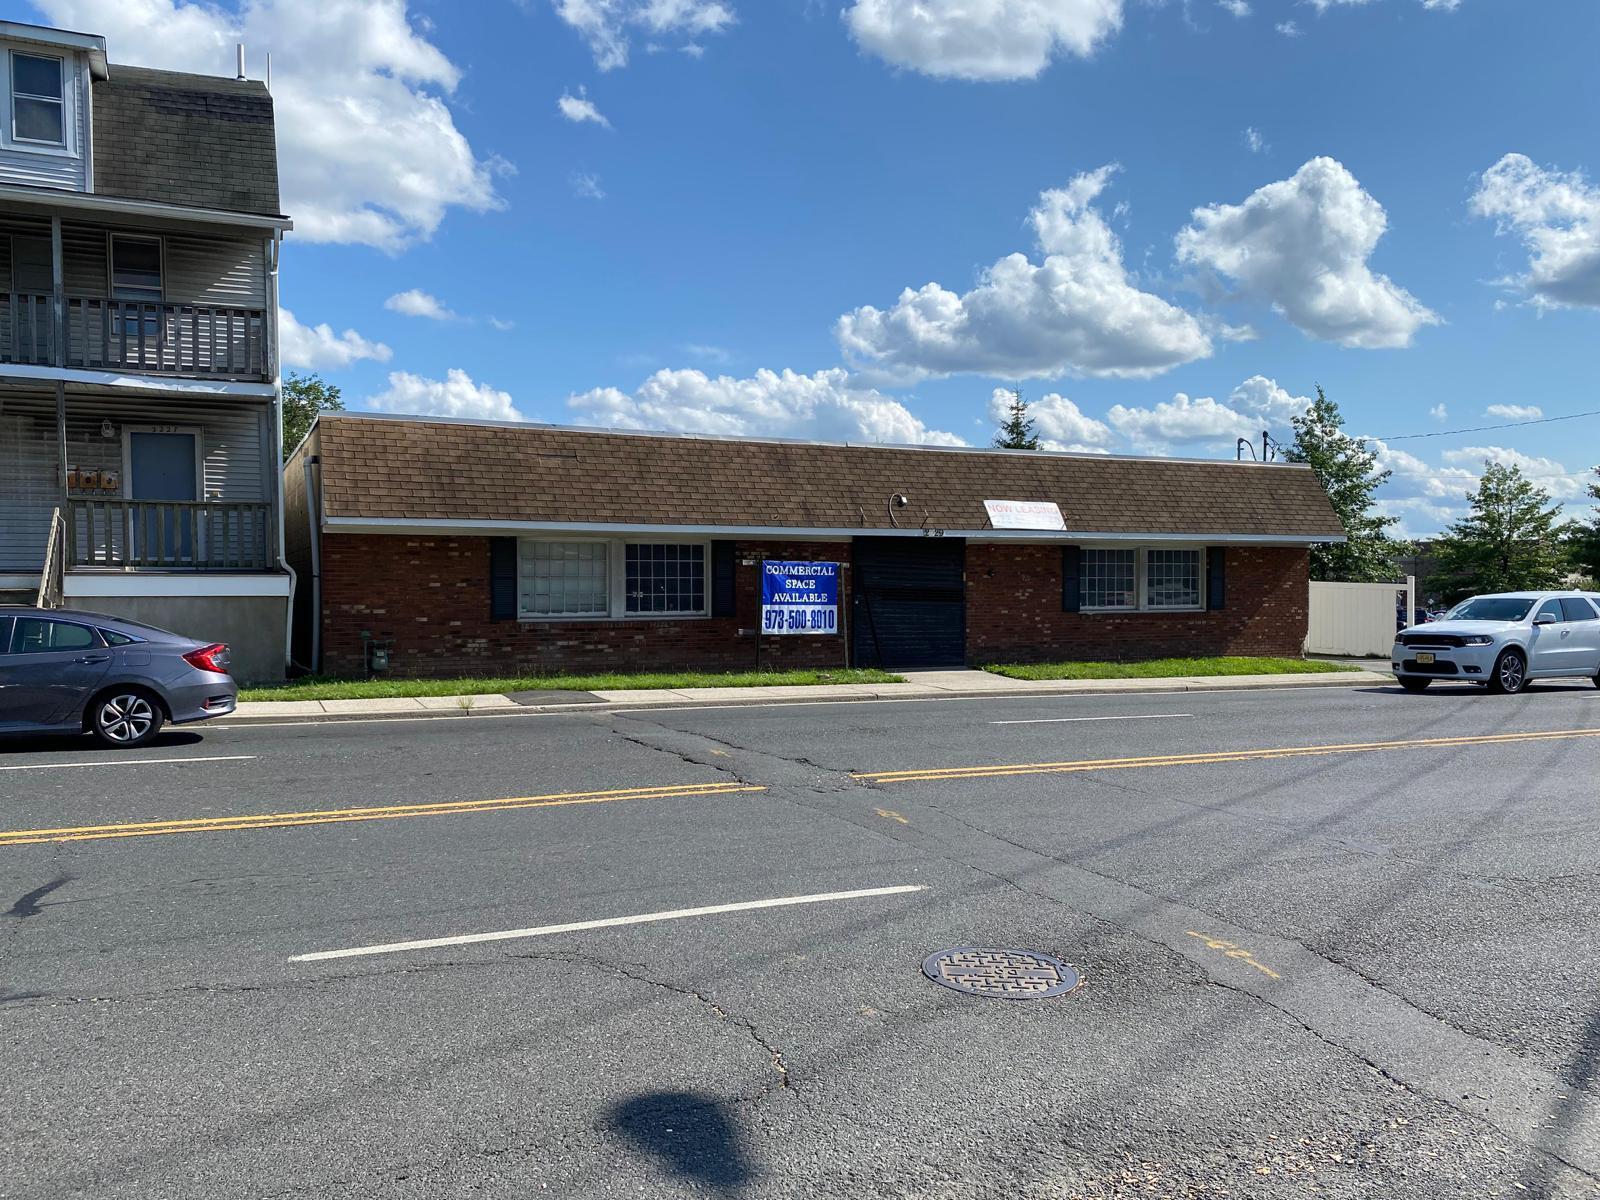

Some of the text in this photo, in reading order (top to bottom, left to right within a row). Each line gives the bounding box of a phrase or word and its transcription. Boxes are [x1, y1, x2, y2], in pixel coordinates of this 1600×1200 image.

[987, 503, 1013, 513] NOW
[766, 565, 835, 576] COMMERCIAL
[785, 579, 816, 589] SPACE
[772, 593, 828, 603] AVAILABLE
[764, 609, 835, 630] 973-500-8010
